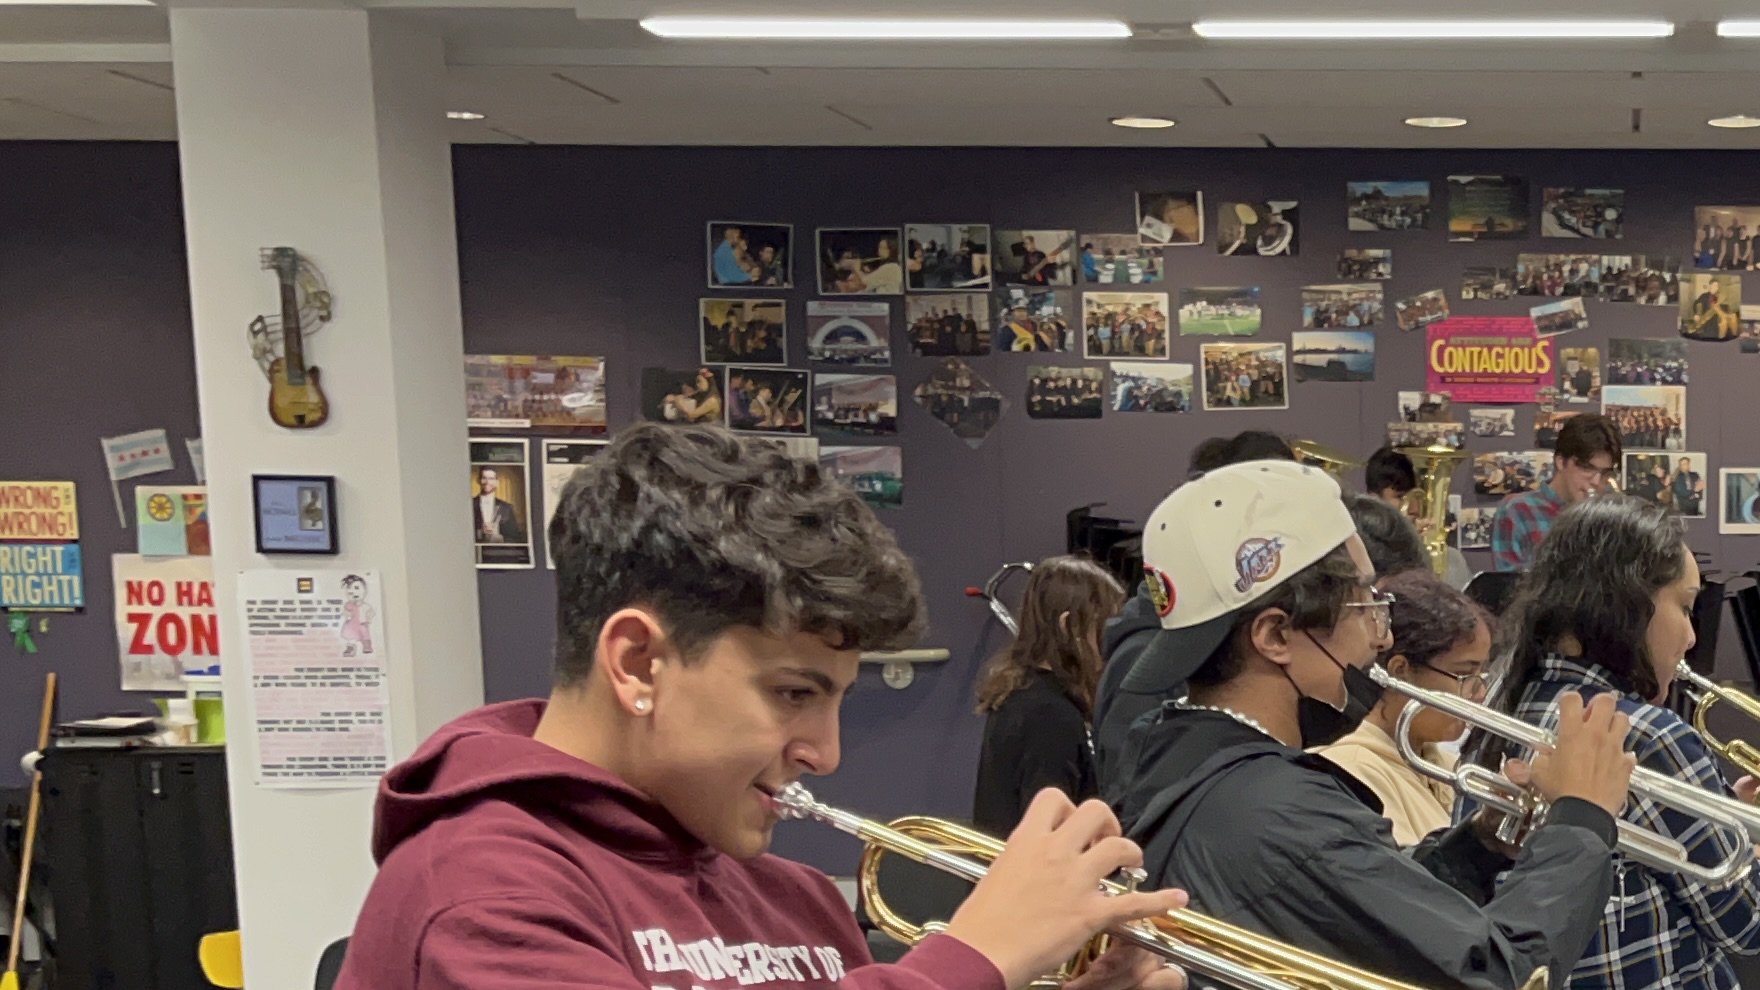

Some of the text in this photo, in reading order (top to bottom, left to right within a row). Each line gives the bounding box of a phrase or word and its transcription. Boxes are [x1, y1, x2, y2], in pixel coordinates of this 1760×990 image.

[1430, 339, 1551, 374] CONTAGIOUS
[0, 511, 74, 536] WRONG!
[0, 546, 64, 573] RIGHT
[2, 575, 81, 605] RIGHT!
[125, 580, 215, 607] NO HA
